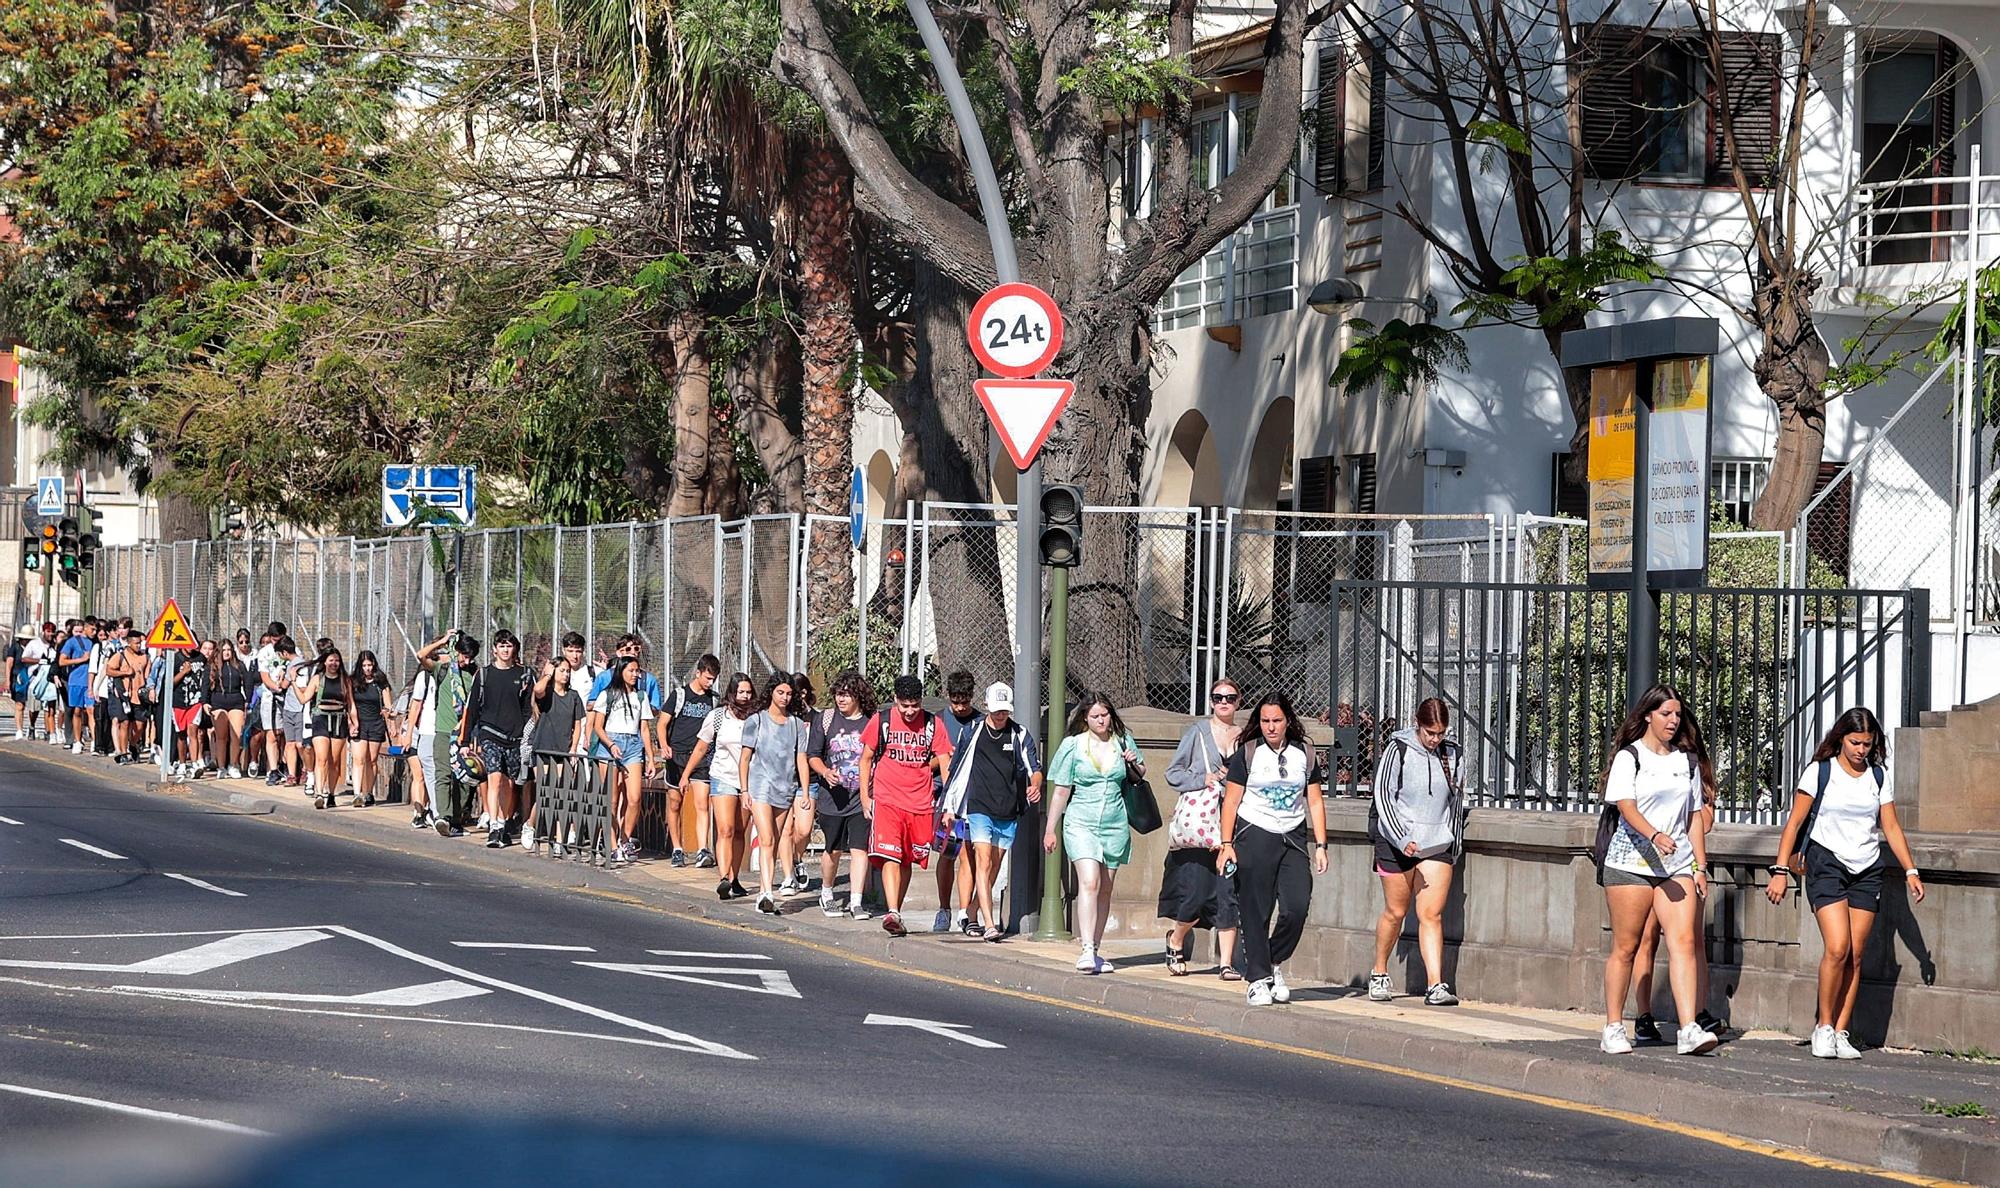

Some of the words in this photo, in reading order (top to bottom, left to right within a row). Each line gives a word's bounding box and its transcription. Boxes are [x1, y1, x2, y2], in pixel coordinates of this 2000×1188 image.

[986, 314, 1046, 349] 24t
[1614, 407, 1635, 418] GOBIERN
[1613, 422, 1619, 432] DE
[1651, 462, 1671, 476] SERVICIO
[1672, 460, 1699, 474] PROVINCIAL
[1651, 487, 1658, 501] DE
[1659, 486, 1676, 500] COSTAS
[1677, 486, 1684, 499] EN
[1684, 485, 1700, 498] SANTA
[1655, 511, 1667, 525] CRUZ
[1667, 511, 1674, 524] DE
[1675, 509, 1696, 524] TENERIFE
[887, 730, 926, 748] CHICAG
[889, 748, 930, 762] BULLS
